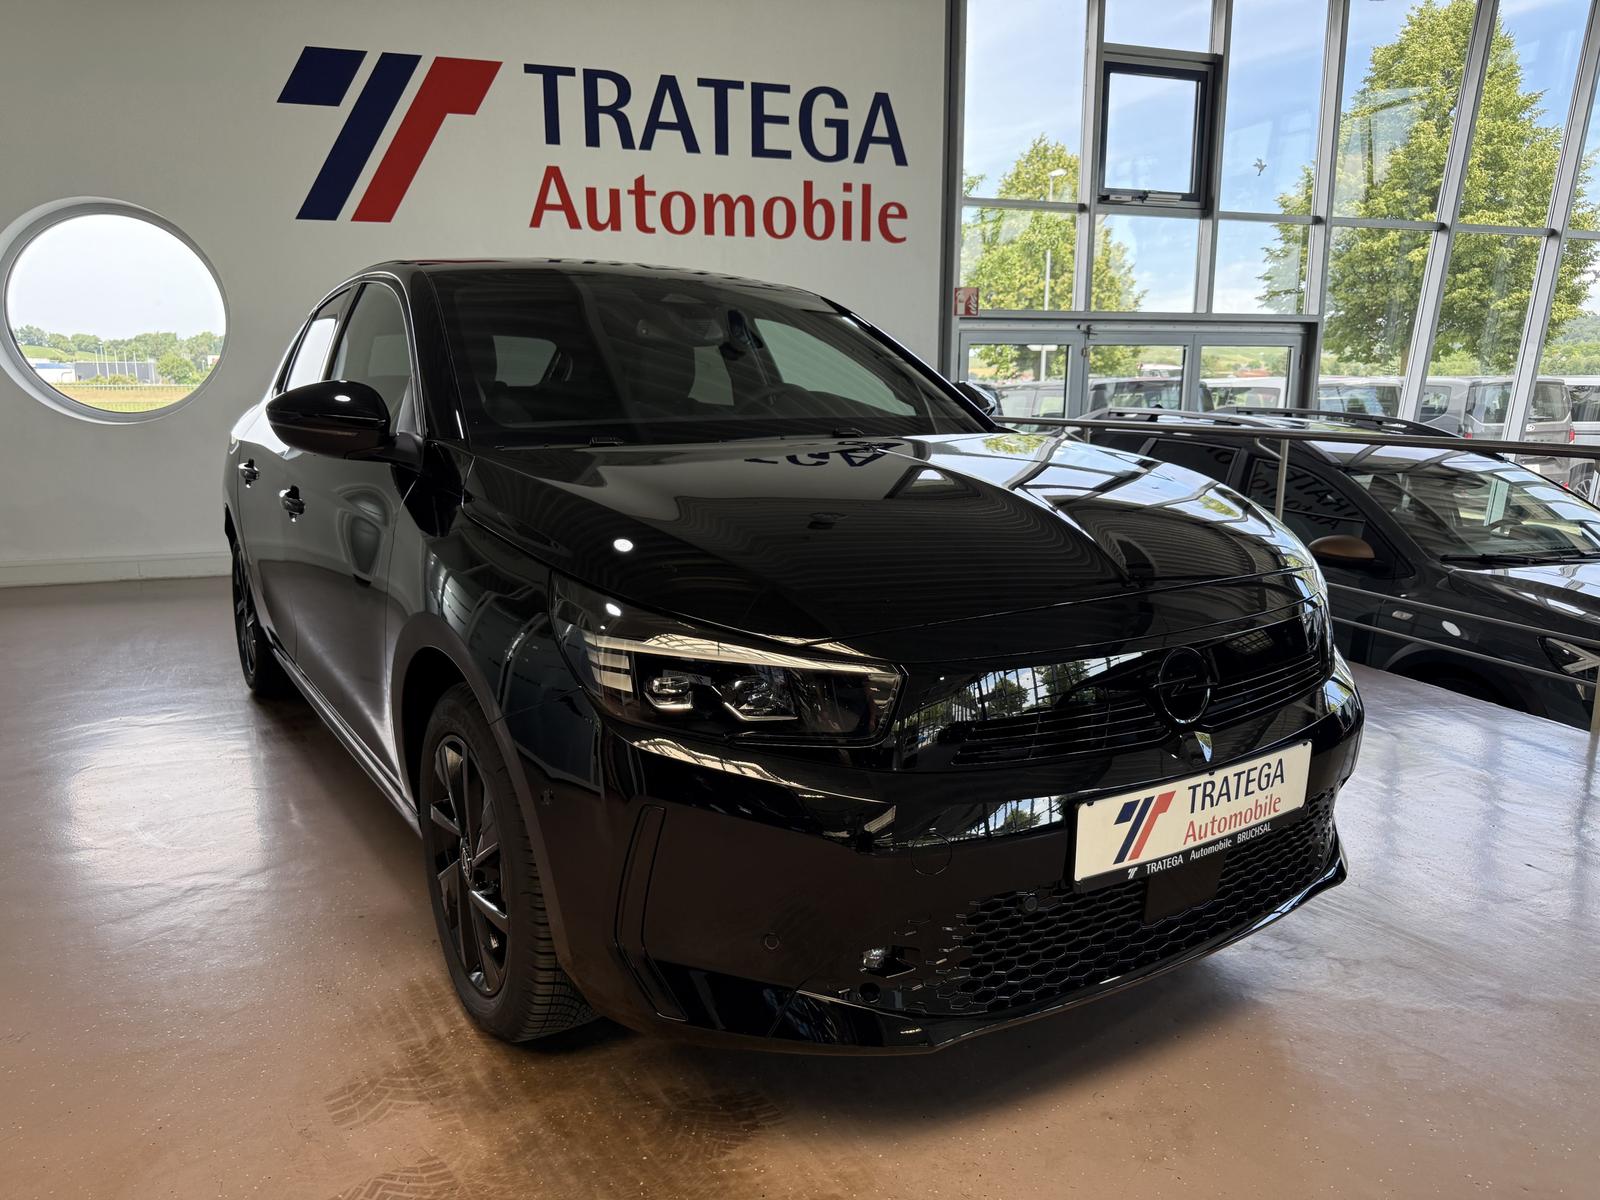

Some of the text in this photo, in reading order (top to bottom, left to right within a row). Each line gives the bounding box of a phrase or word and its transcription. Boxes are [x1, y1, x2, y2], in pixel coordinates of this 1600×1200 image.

[523, 63, 909, 167] TRATEGA
[528, 165, 909, 244] Automobile
[1187, 758, 1285, 814] TRATEGA
[1183, 794, 1282, 845] Automobile
[1146, 821, 1272, 875] TRATEGA Automobile BRUCHSAL
